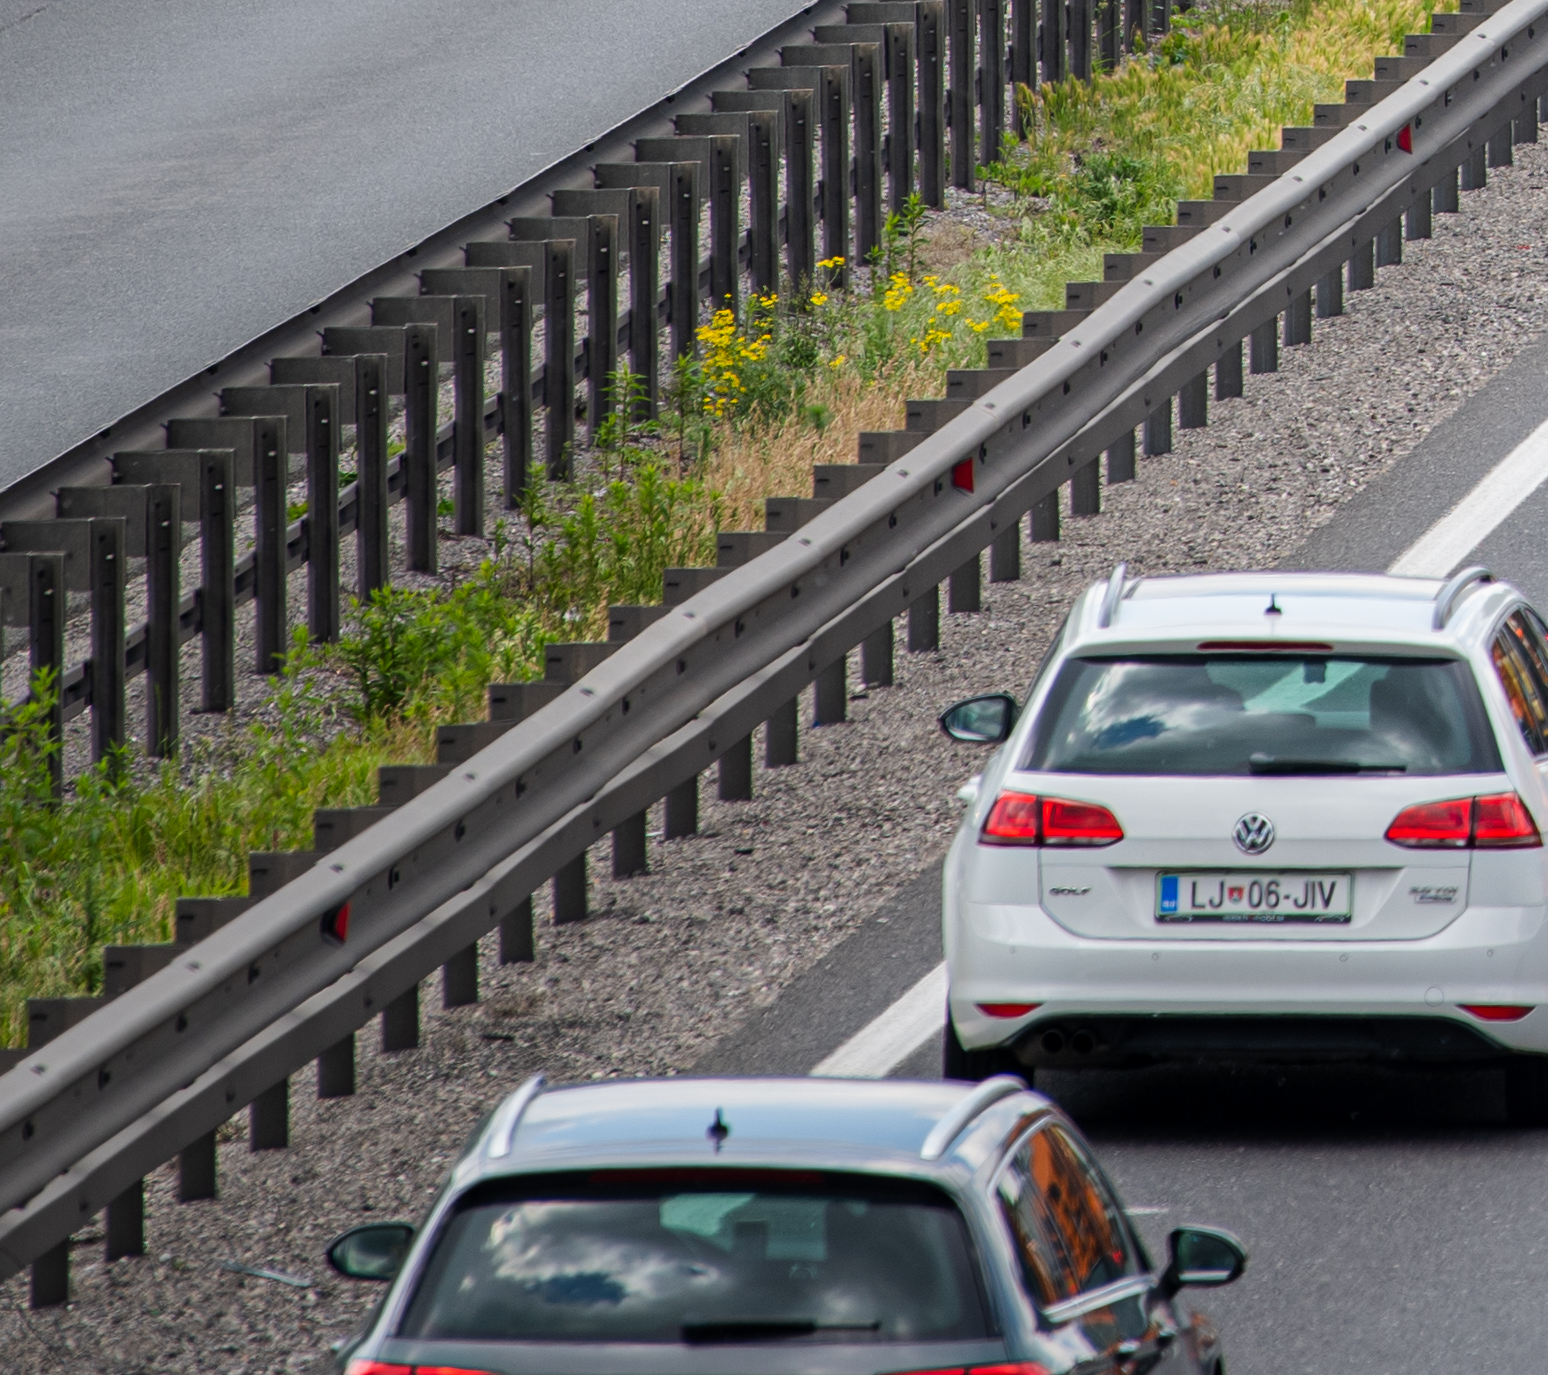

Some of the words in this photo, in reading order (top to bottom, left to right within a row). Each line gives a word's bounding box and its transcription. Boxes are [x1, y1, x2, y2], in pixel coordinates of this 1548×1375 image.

[1049, 886, 1093, 897] GOLF
[1191, 880, 1224, 909] LJ
[1248, 879, 1337, 910] 06-JIV
